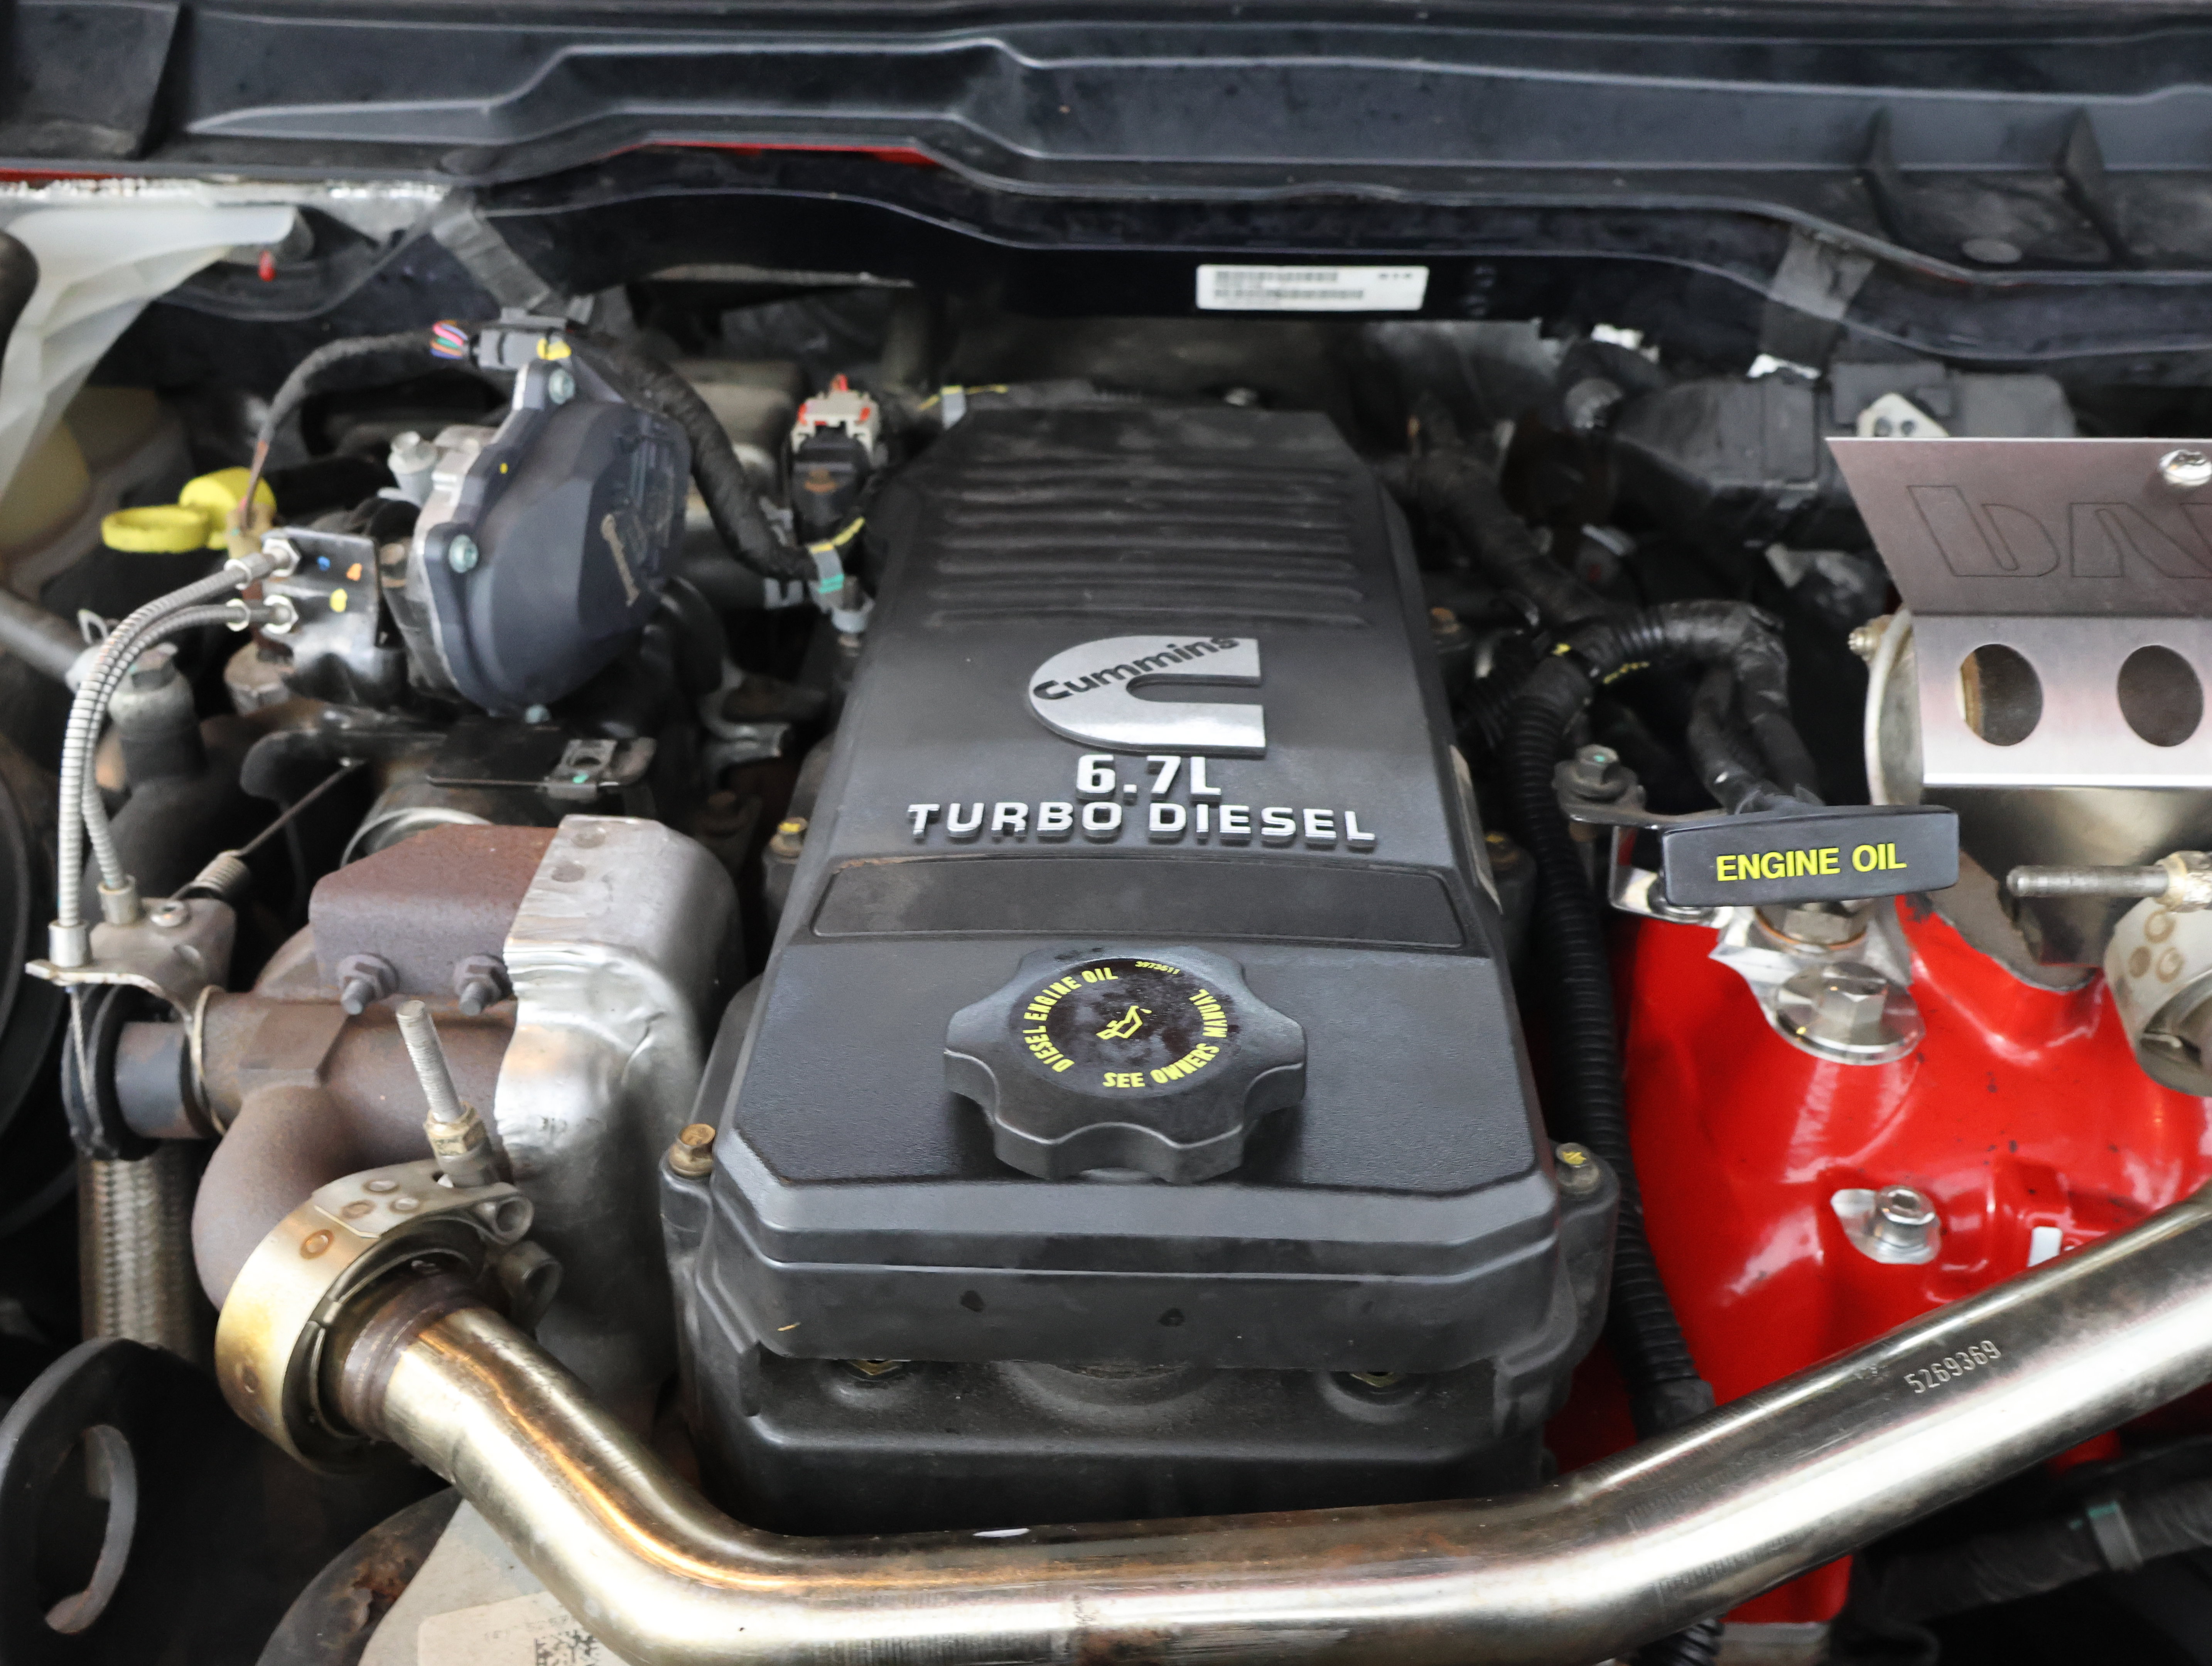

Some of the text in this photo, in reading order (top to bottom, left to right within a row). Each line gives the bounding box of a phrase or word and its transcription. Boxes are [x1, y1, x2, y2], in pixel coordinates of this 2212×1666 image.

[1033, 636, 1240, 700] Cummins
[1076, 754, 1222, 802] 6.7L
[908, 802, 1376, 847] TURBO DIESEL
[1716, 843, 1907, 882] ENGINE OIL
[1022, 967, 1118, 1073] DIESEL ENGINE OIL
[1102, 988, 1228, 1088] SEE OWNERS MANUAL
[1903, 1340, 2002, 1394] 5269369
